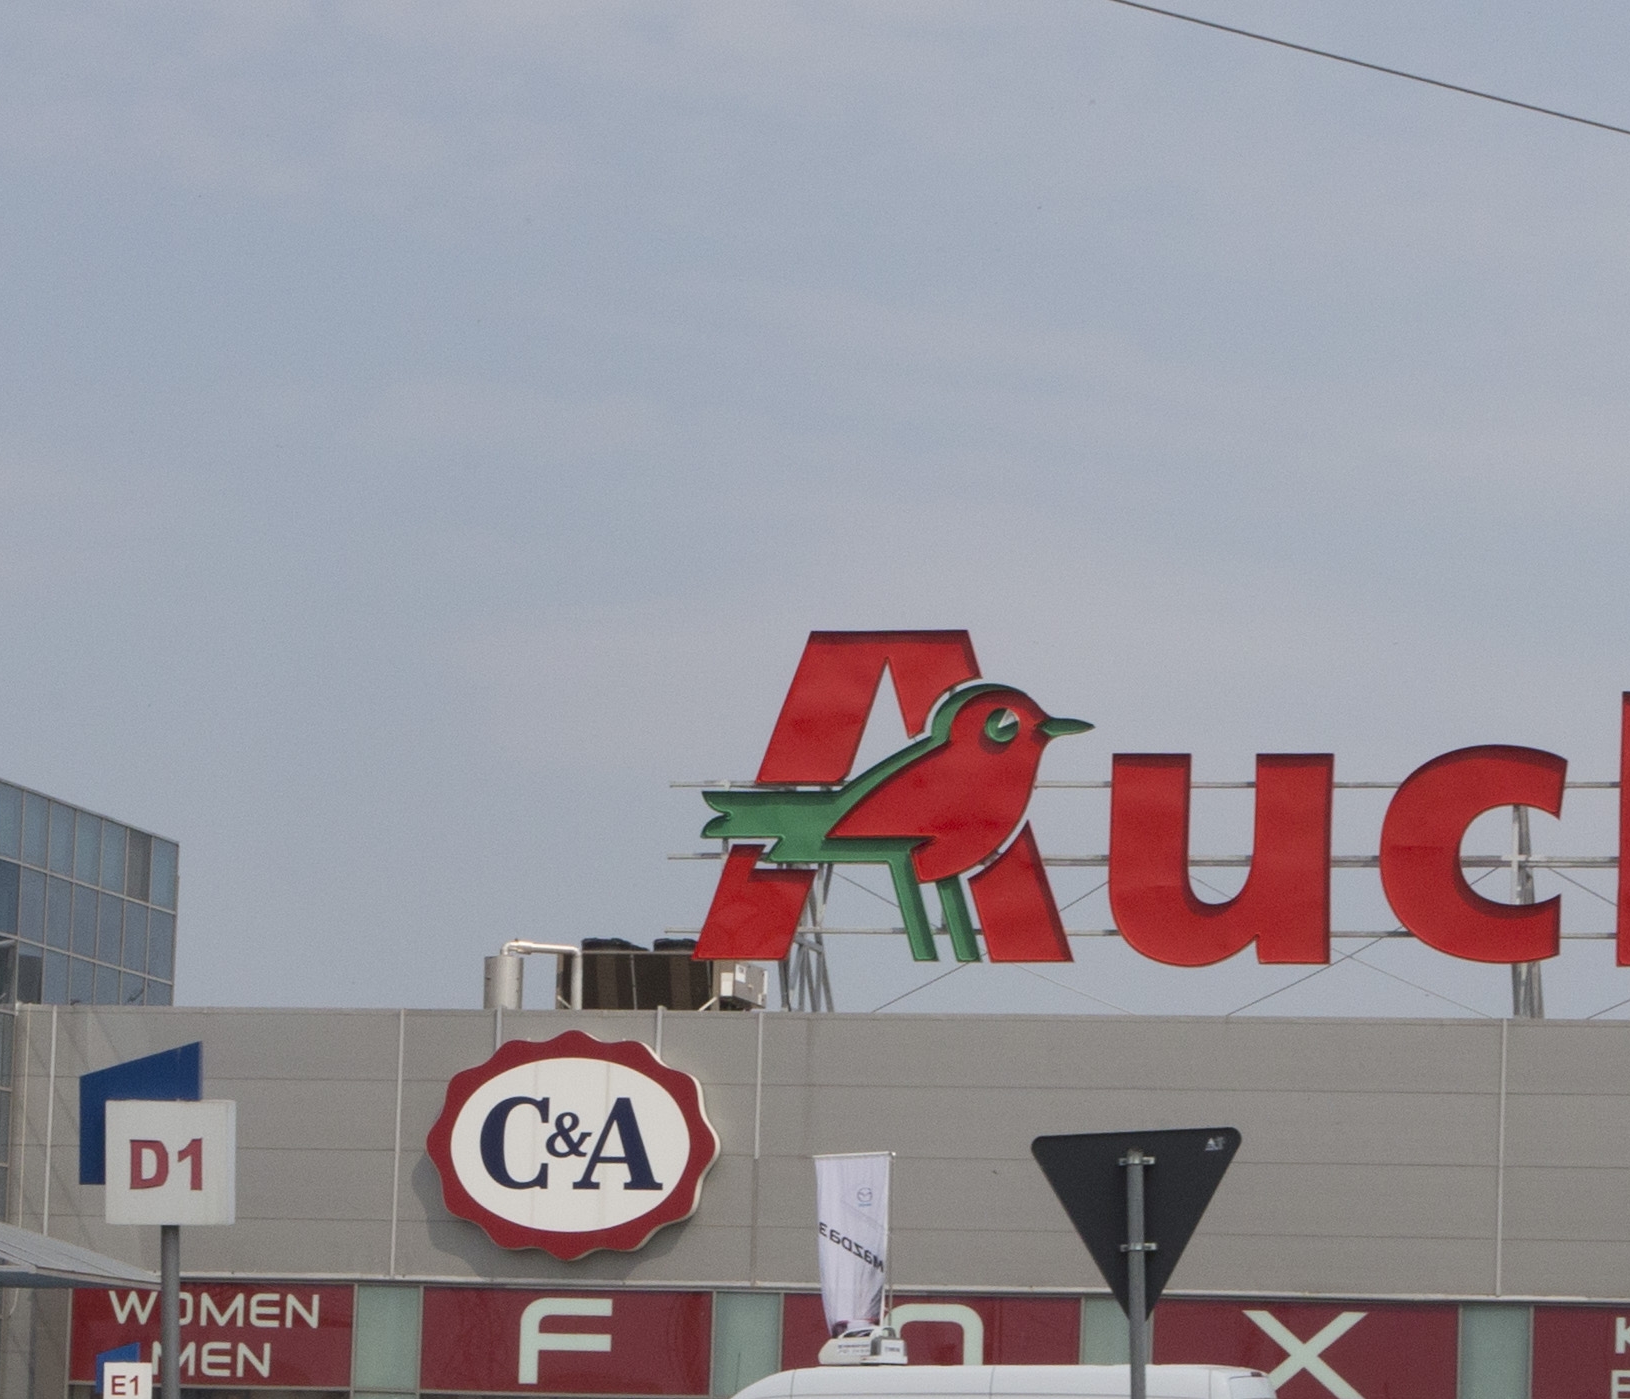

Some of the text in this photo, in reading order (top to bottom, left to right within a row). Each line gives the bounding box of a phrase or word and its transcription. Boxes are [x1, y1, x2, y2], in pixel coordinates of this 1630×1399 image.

[129, 1138, 203, 1191] D1
[480, 1096, 663, 1190] C&A
[152, 1341, 271, 1378] MEN
[111, 1375, 139, 1396] E1
